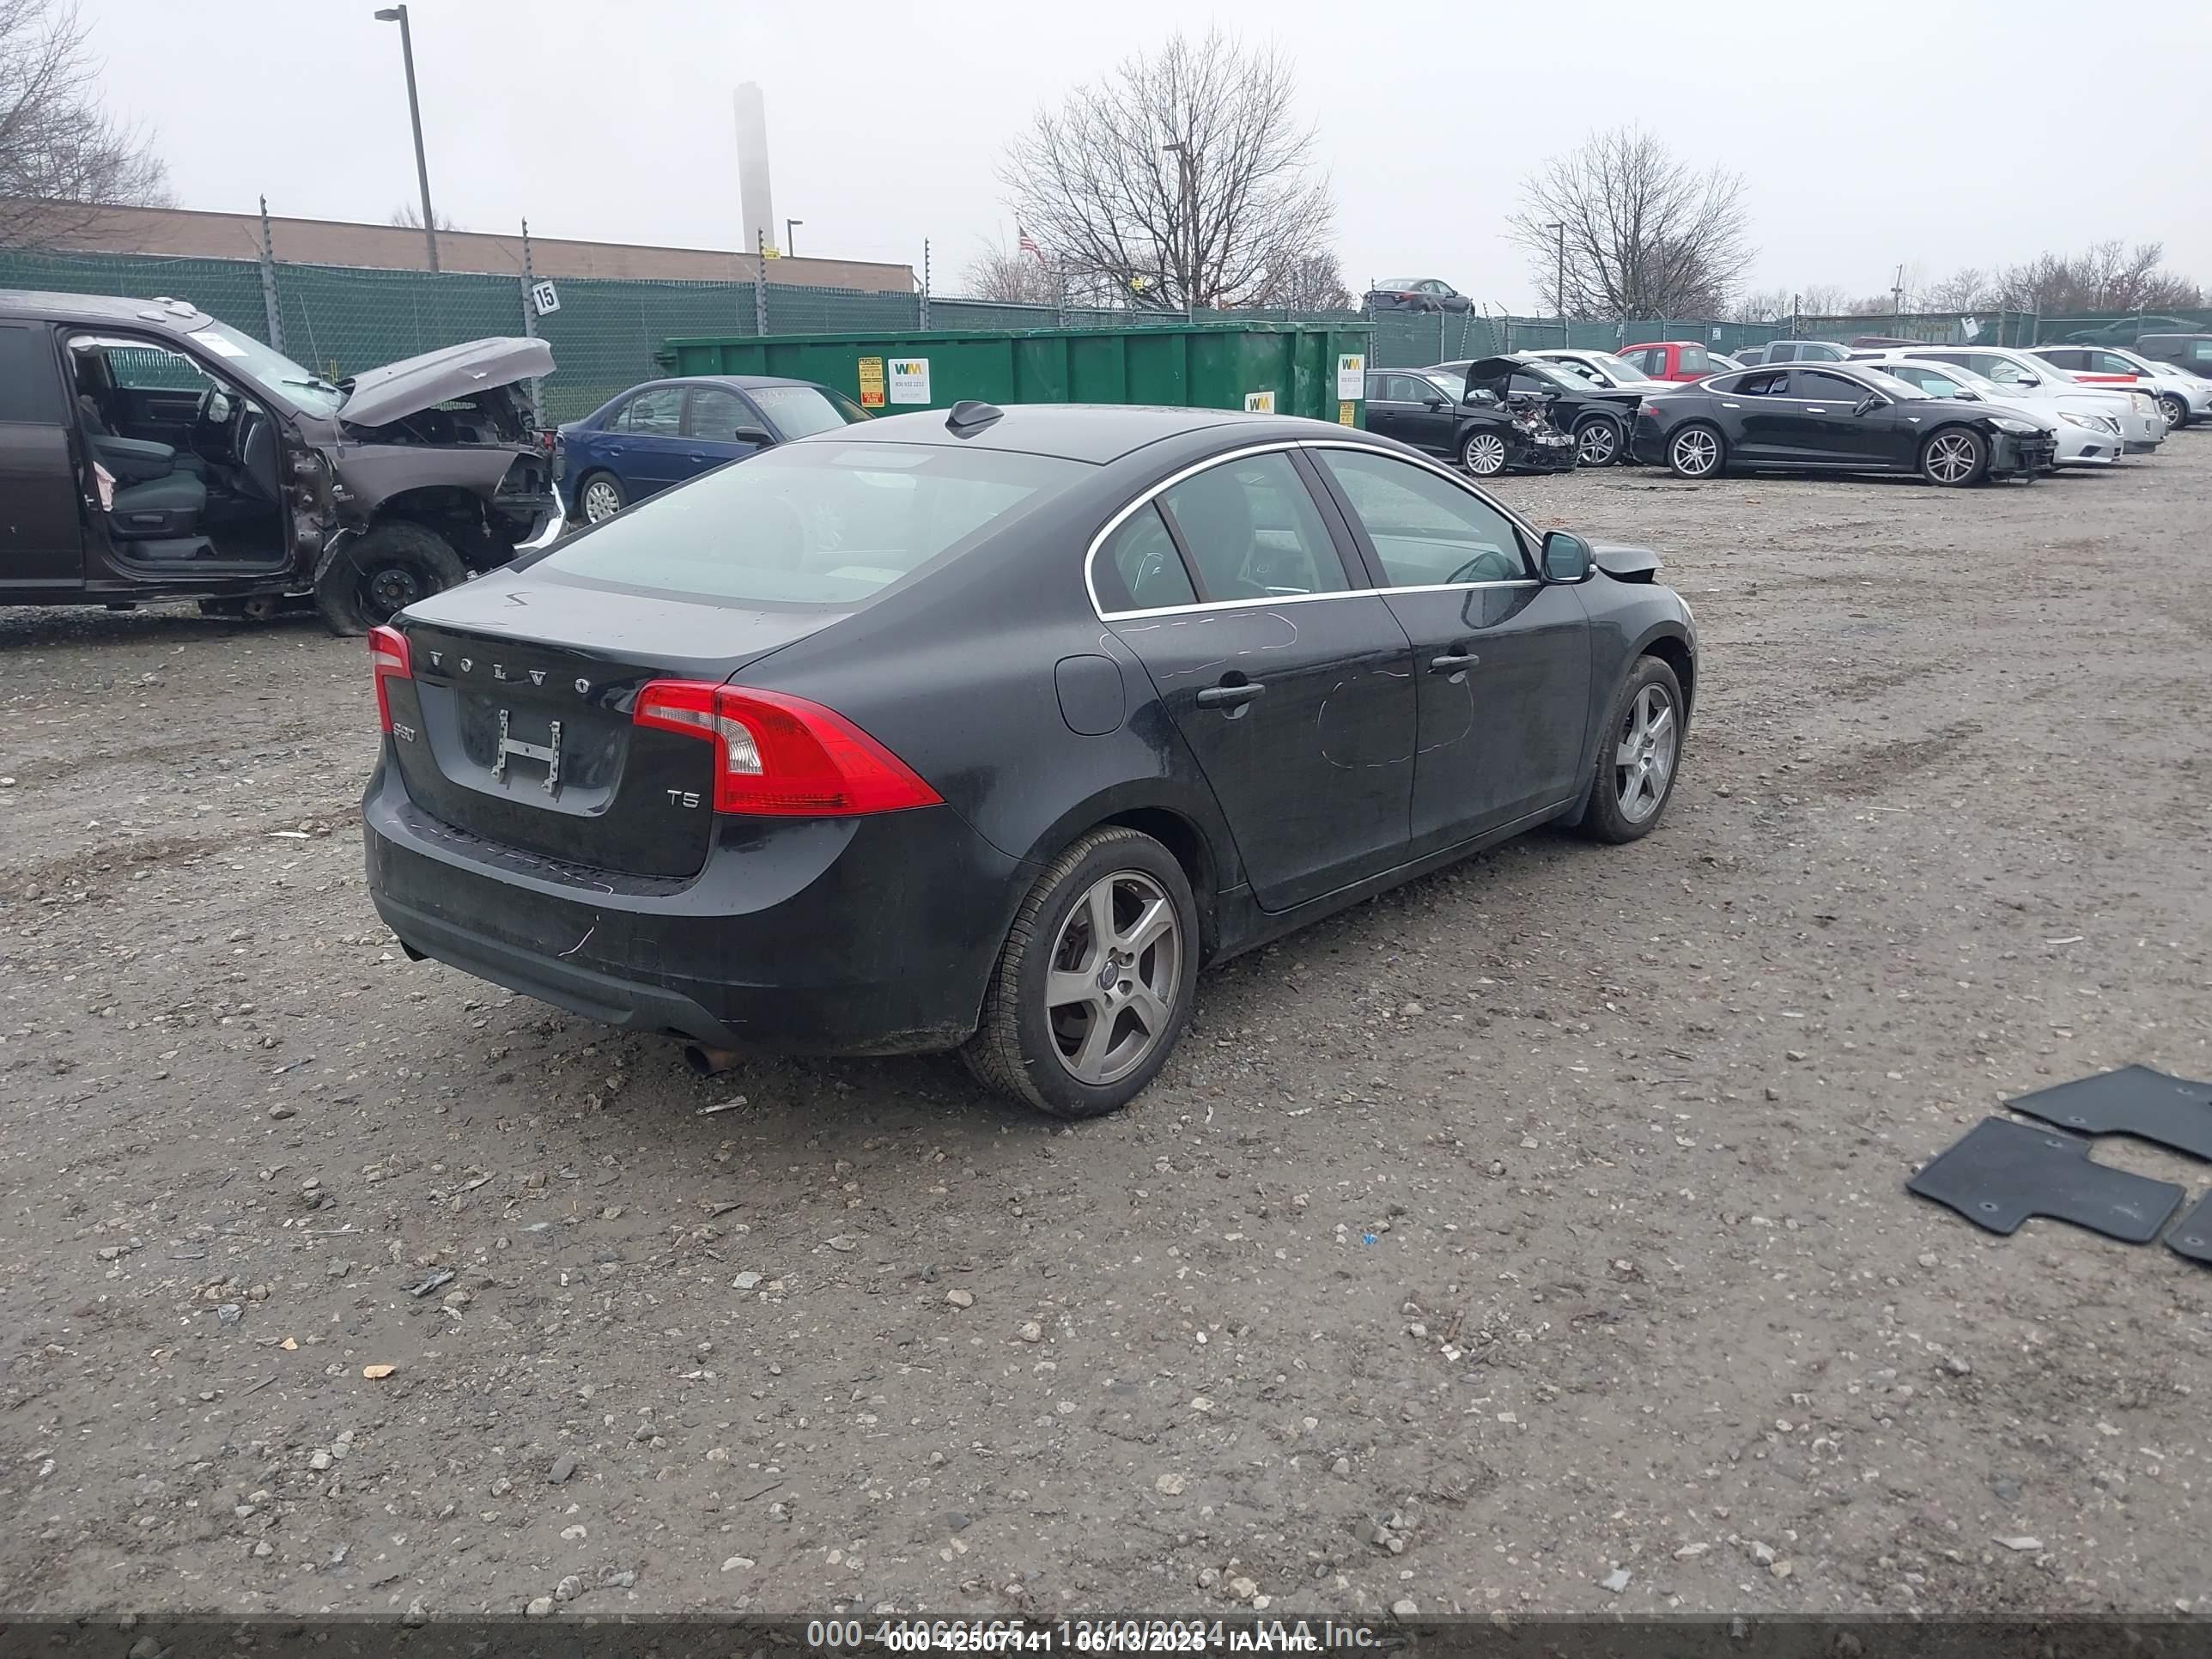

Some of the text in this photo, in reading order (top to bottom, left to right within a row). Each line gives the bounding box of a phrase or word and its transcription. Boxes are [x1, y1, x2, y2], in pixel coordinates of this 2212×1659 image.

[536, 287, 555, 308] 15
[895, 363, 921, 374] WM
[1342, 358, 1360, 370] WM
[1249, 398, 1270, 410] WM
[430, 651, 591, 695] VOLVO
[667, 789, 701, 809] T5
